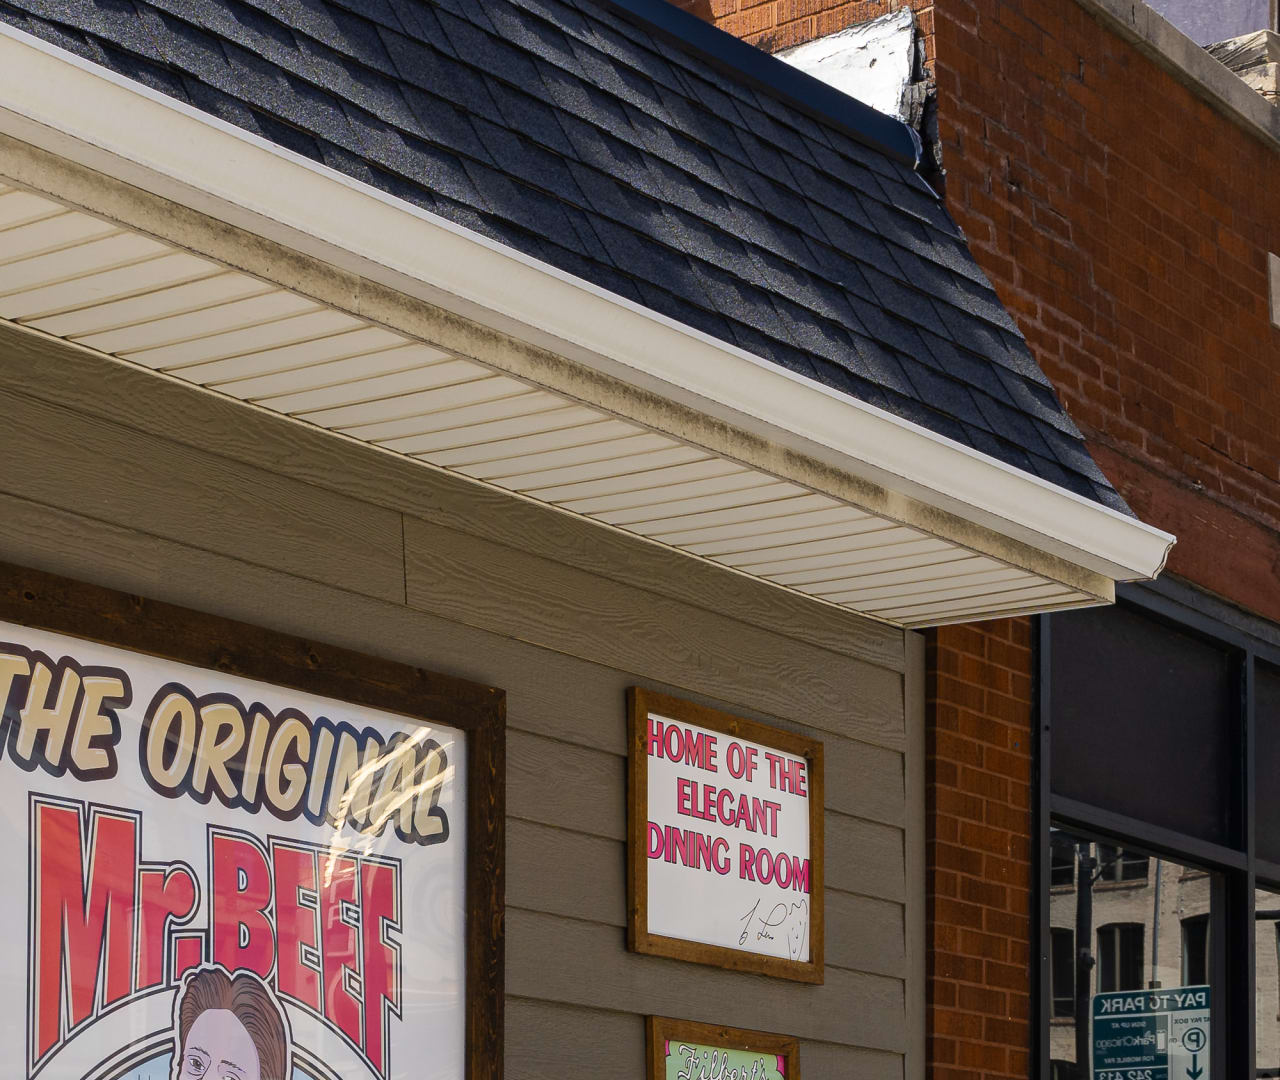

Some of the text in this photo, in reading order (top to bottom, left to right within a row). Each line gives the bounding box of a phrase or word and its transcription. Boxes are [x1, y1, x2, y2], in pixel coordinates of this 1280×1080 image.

[139, 682, 453, 846] ORIGINAL
[647, 718, 807, 798] HOME OF THE
[676, 777, 782, 838] ELEGANT
[647, 820, 810, 894] DINING ROOM
